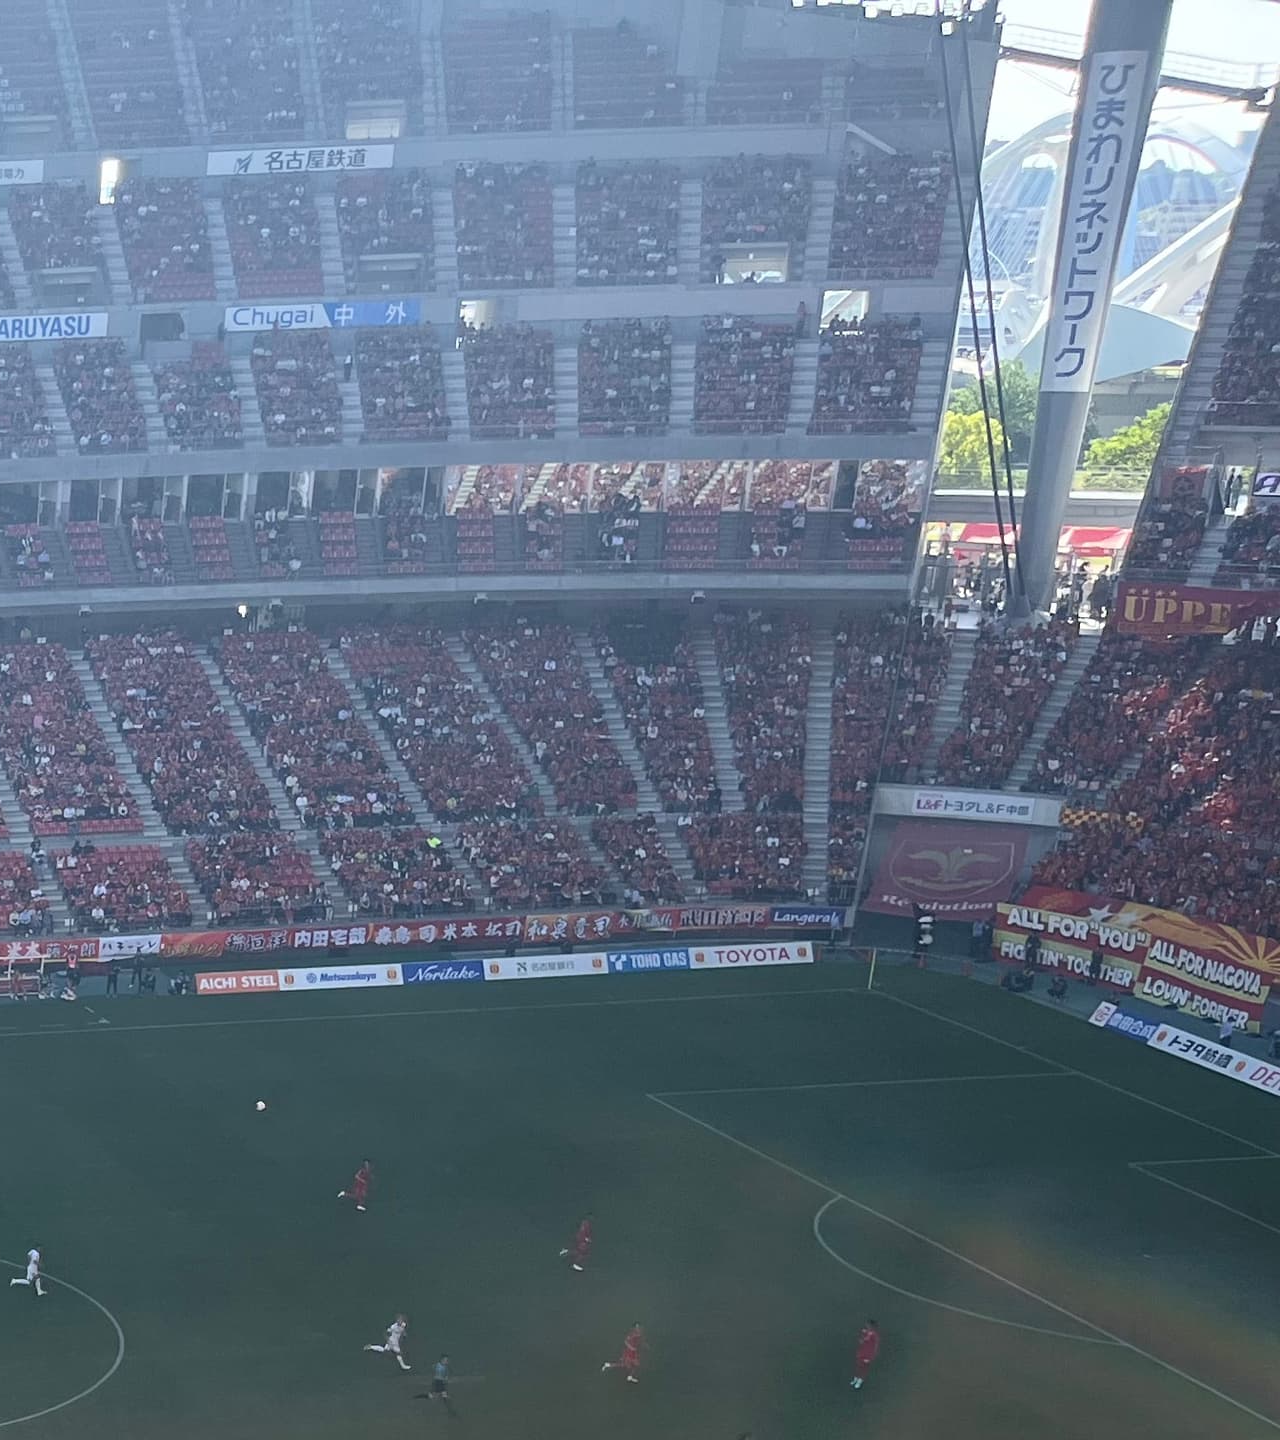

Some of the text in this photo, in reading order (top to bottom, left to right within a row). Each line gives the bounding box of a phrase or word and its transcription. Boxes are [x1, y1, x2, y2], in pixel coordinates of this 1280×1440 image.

[264, 146, 368, 173] 名古屋鉄道
[1054, 63, 1137, 378] ひまわりネットワーク
[232, 306, 315, 330] Chugai
[1007, 907, 1045, 931] ALL
[1047, 914, 1090, 941] FOR
[294, 927, 366, 948] 内田宅哉
[663, 950, 687, 967] GAS
[714, 947, 790, 964] TOYOTA
[1149, 938, 1262, 996] ALL FOR NAGOYA
[199, 973, 278, 990] AICHI STEEL
[407, 963, 480, 982] Noritake
[1064, 954, 1133, 988] TOGTHER
[1192, 994, 1249, 1030] FOREVER
